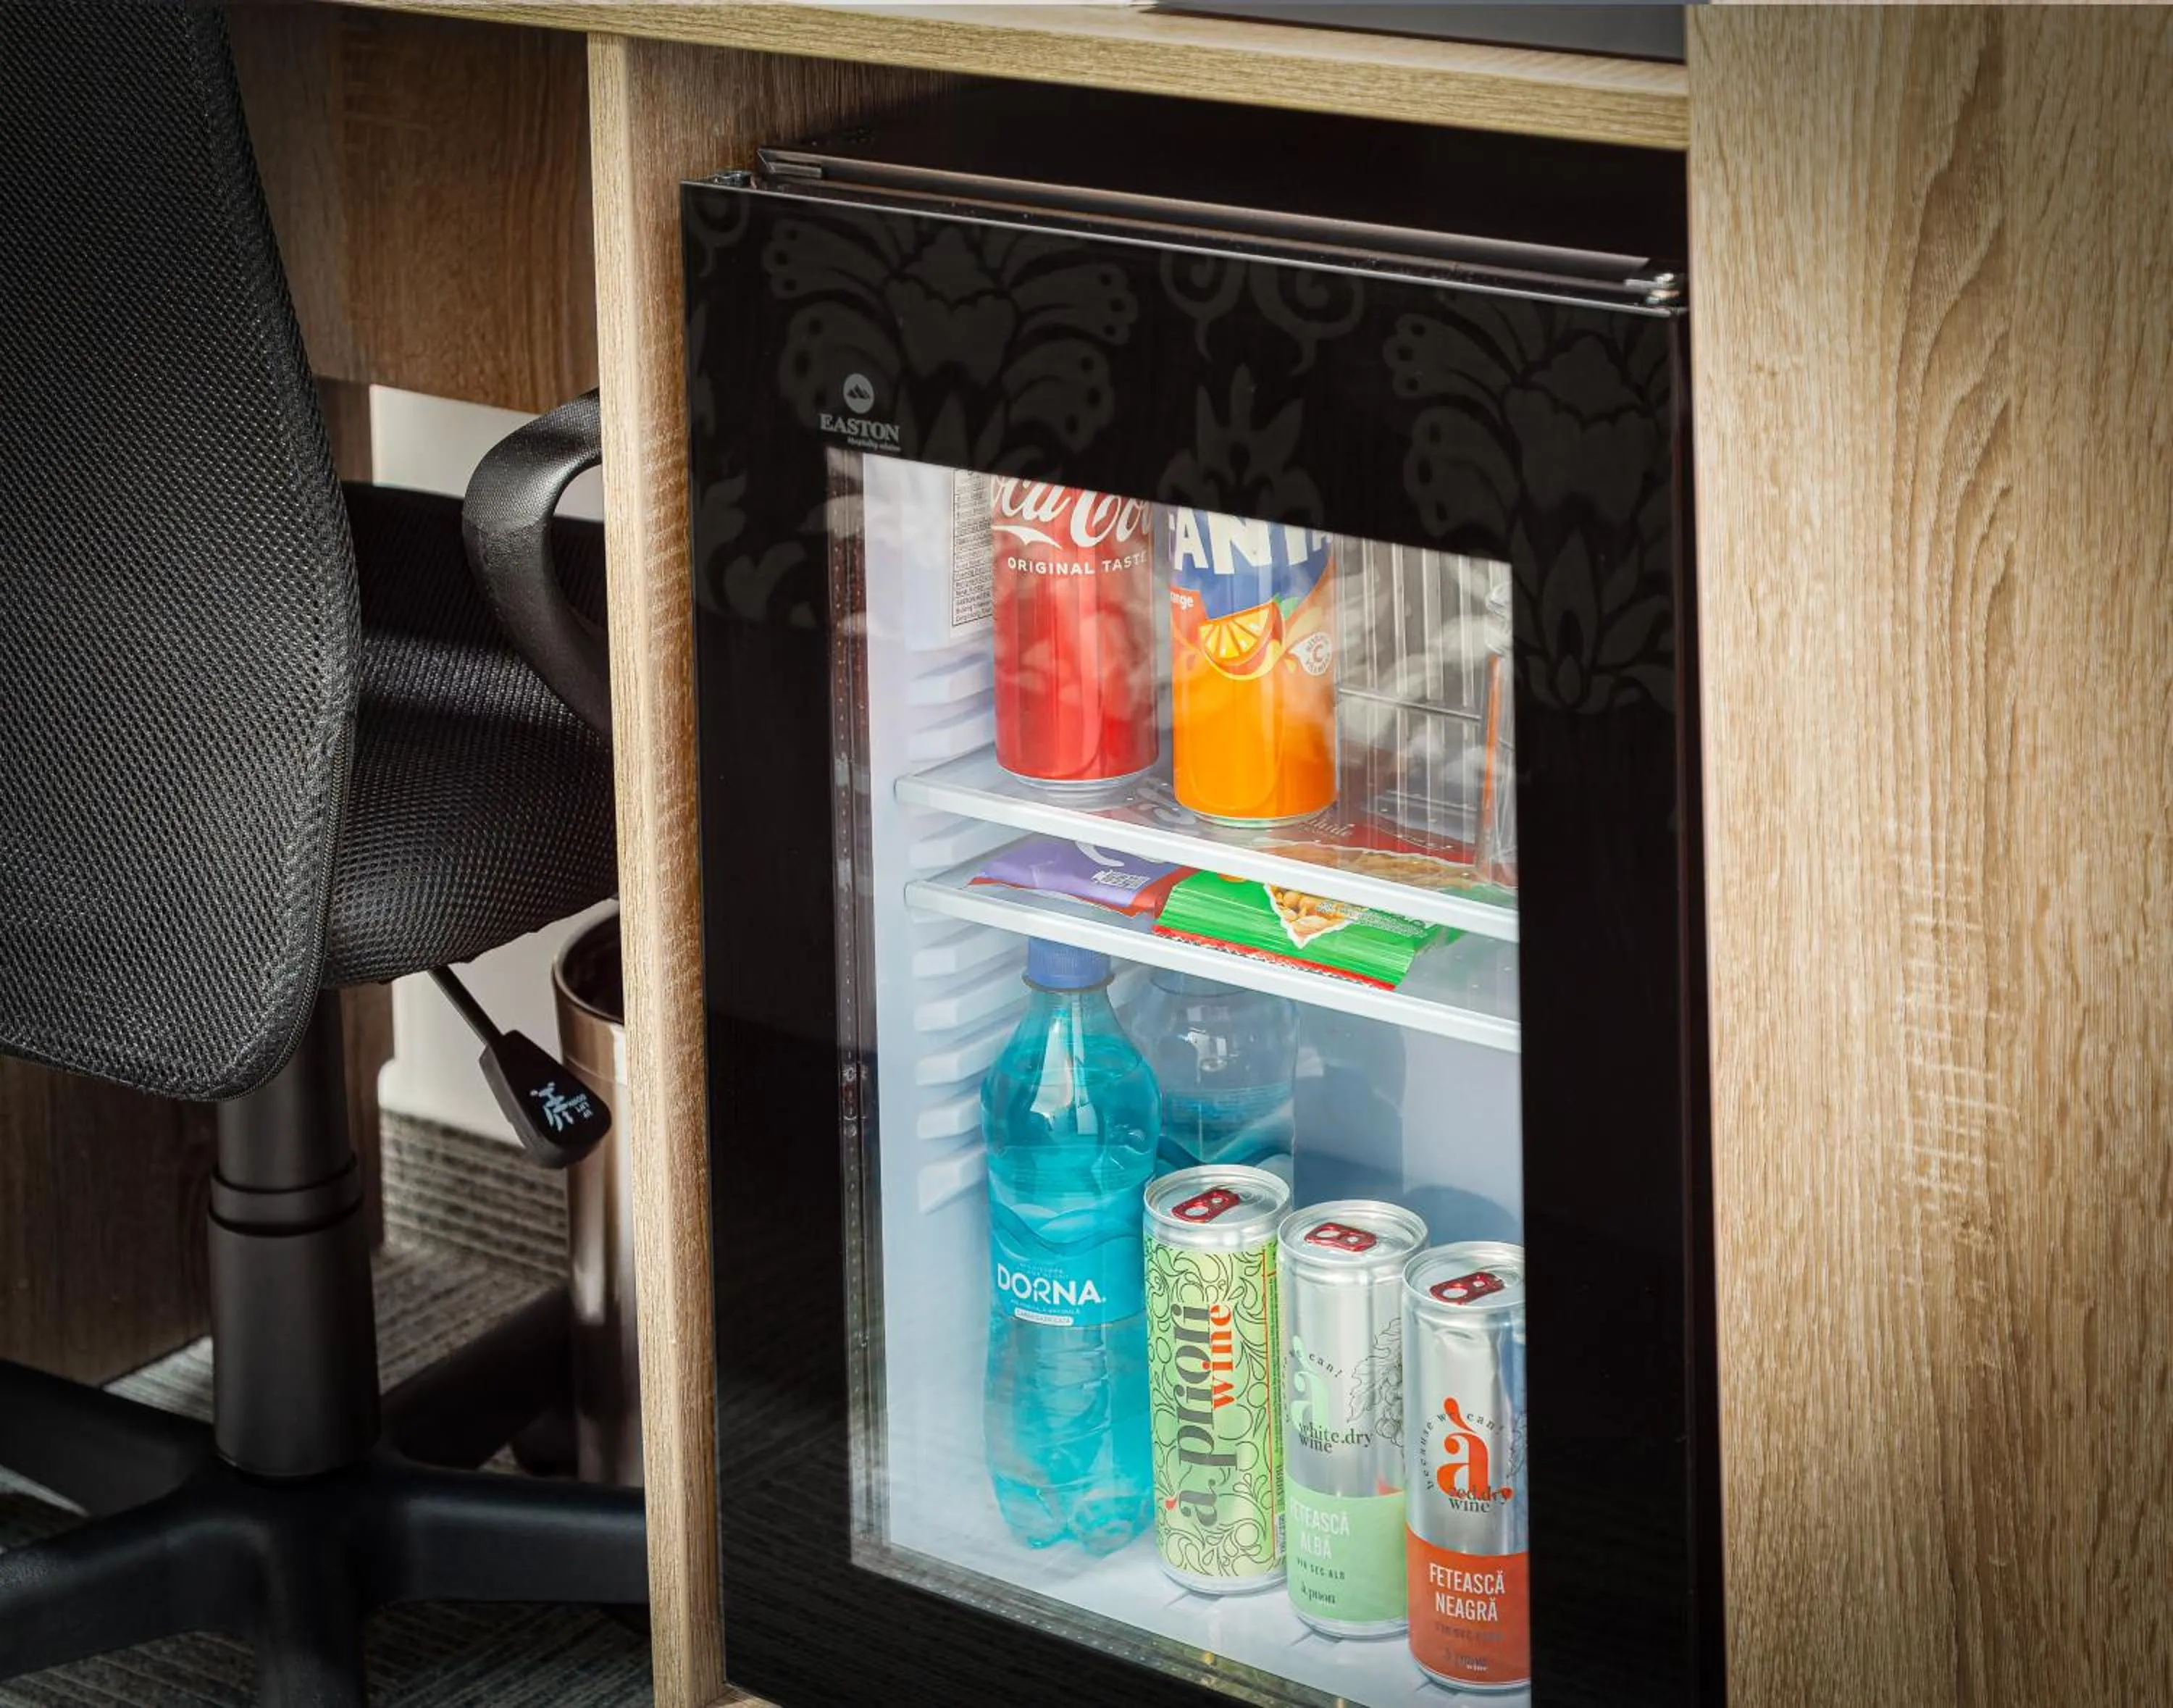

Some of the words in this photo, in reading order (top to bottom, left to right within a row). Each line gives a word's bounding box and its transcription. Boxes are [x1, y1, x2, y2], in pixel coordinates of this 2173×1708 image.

[819, 413, 900, 443] EASTON
[1008, 556, 1095, 574] ORIGINAL
[997, 1263, 1102, 1305] DORNA
[1201, 1303, 1238, 1411] wine
[1449, 1496, 1491, 1513] wine
[1429, 1562, 1506, 1595] FETEASCĂ
[1435, 1591, 1499, 1622] NEAGRĂ
